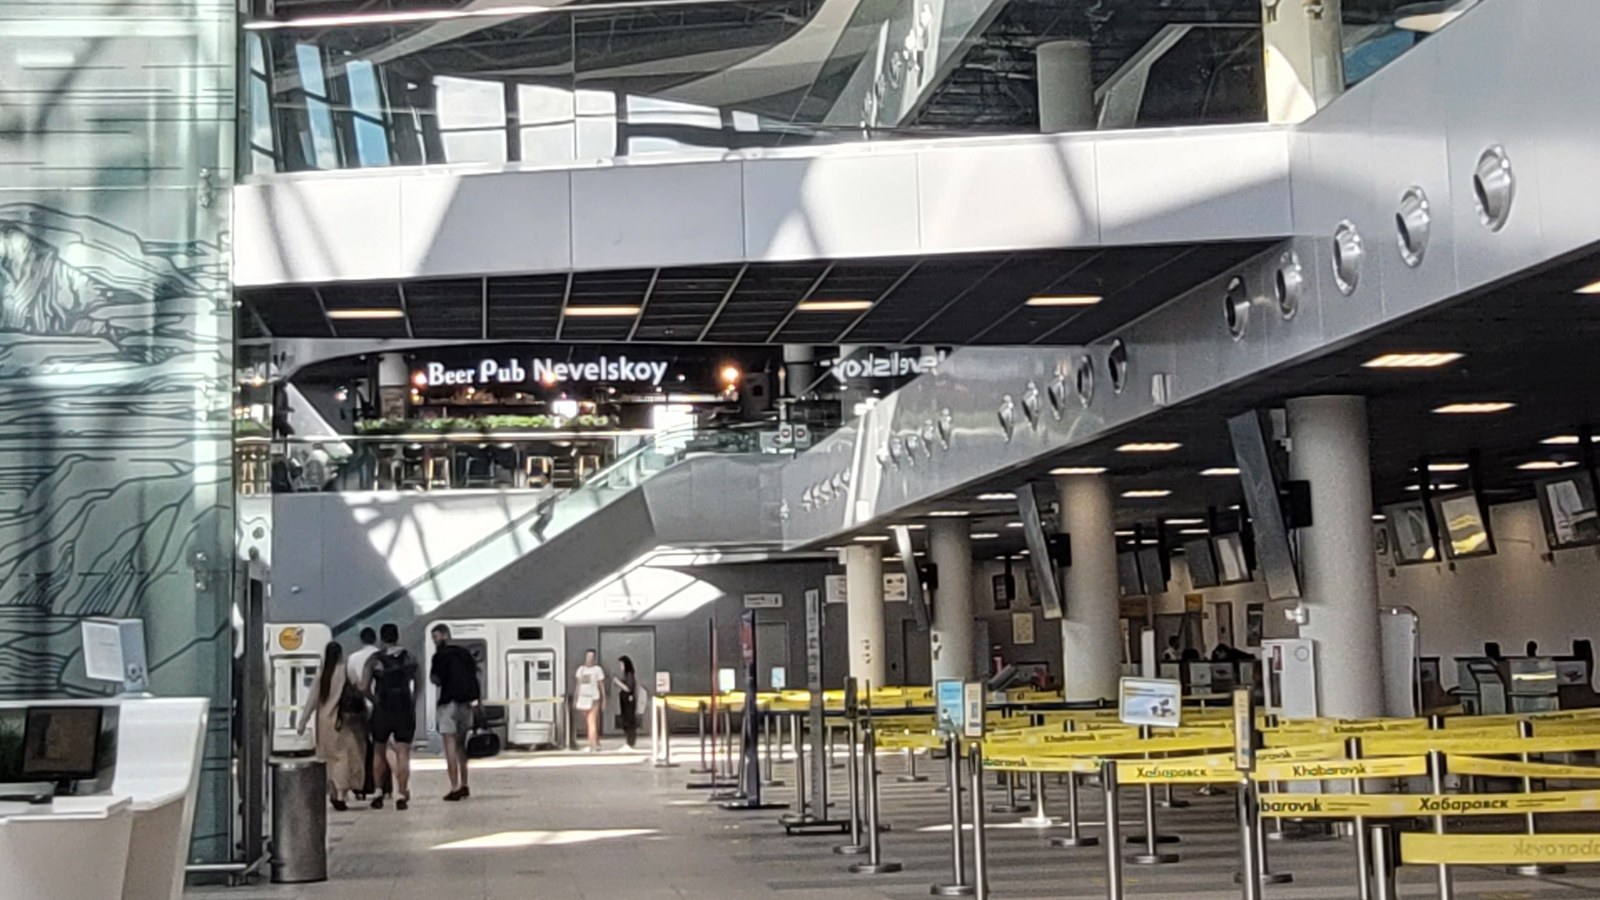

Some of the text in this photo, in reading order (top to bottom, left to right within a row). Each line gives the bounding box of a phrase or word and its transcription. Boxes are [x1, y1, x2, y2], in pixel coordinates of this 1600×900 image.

[428, 356, 668, 386] Beer Pub Nevelskoy
[1136, 767, 1208, 779] Хабаровск
[1292, 763, 1367, 777] Khabarovsk
[1257, 798, 1322, 812] barovsk
[1419, 797, 1509, 813] Хабаровск
